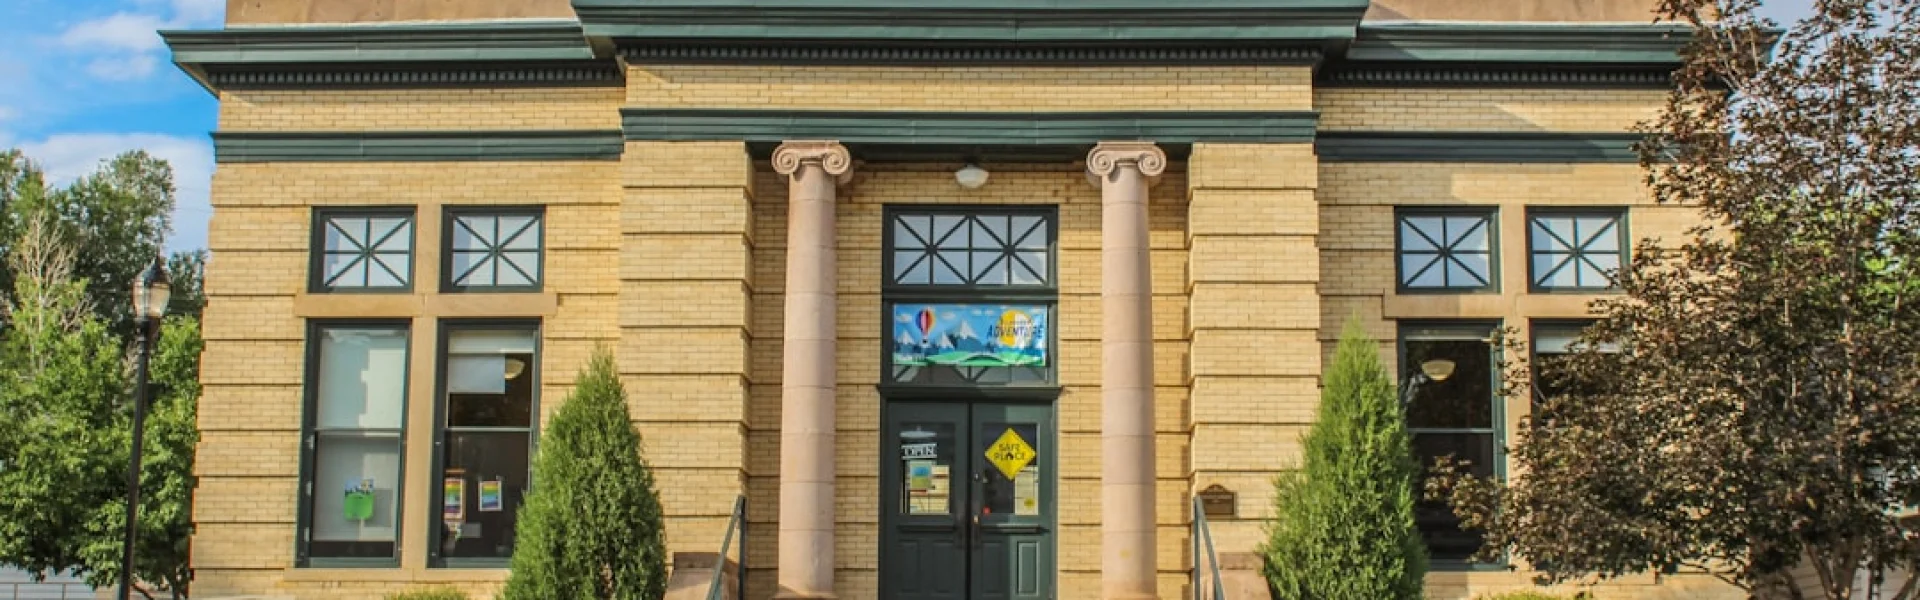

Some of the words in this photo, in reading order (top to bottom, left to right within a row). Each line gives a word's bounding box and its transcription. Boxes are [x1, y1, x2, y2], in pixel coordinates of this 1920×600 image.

[986, 324, 1043, 340] ADVENTURE
[903, 446, 936, 456] OPEN
[998, 443, 1020, 451] SAFE
